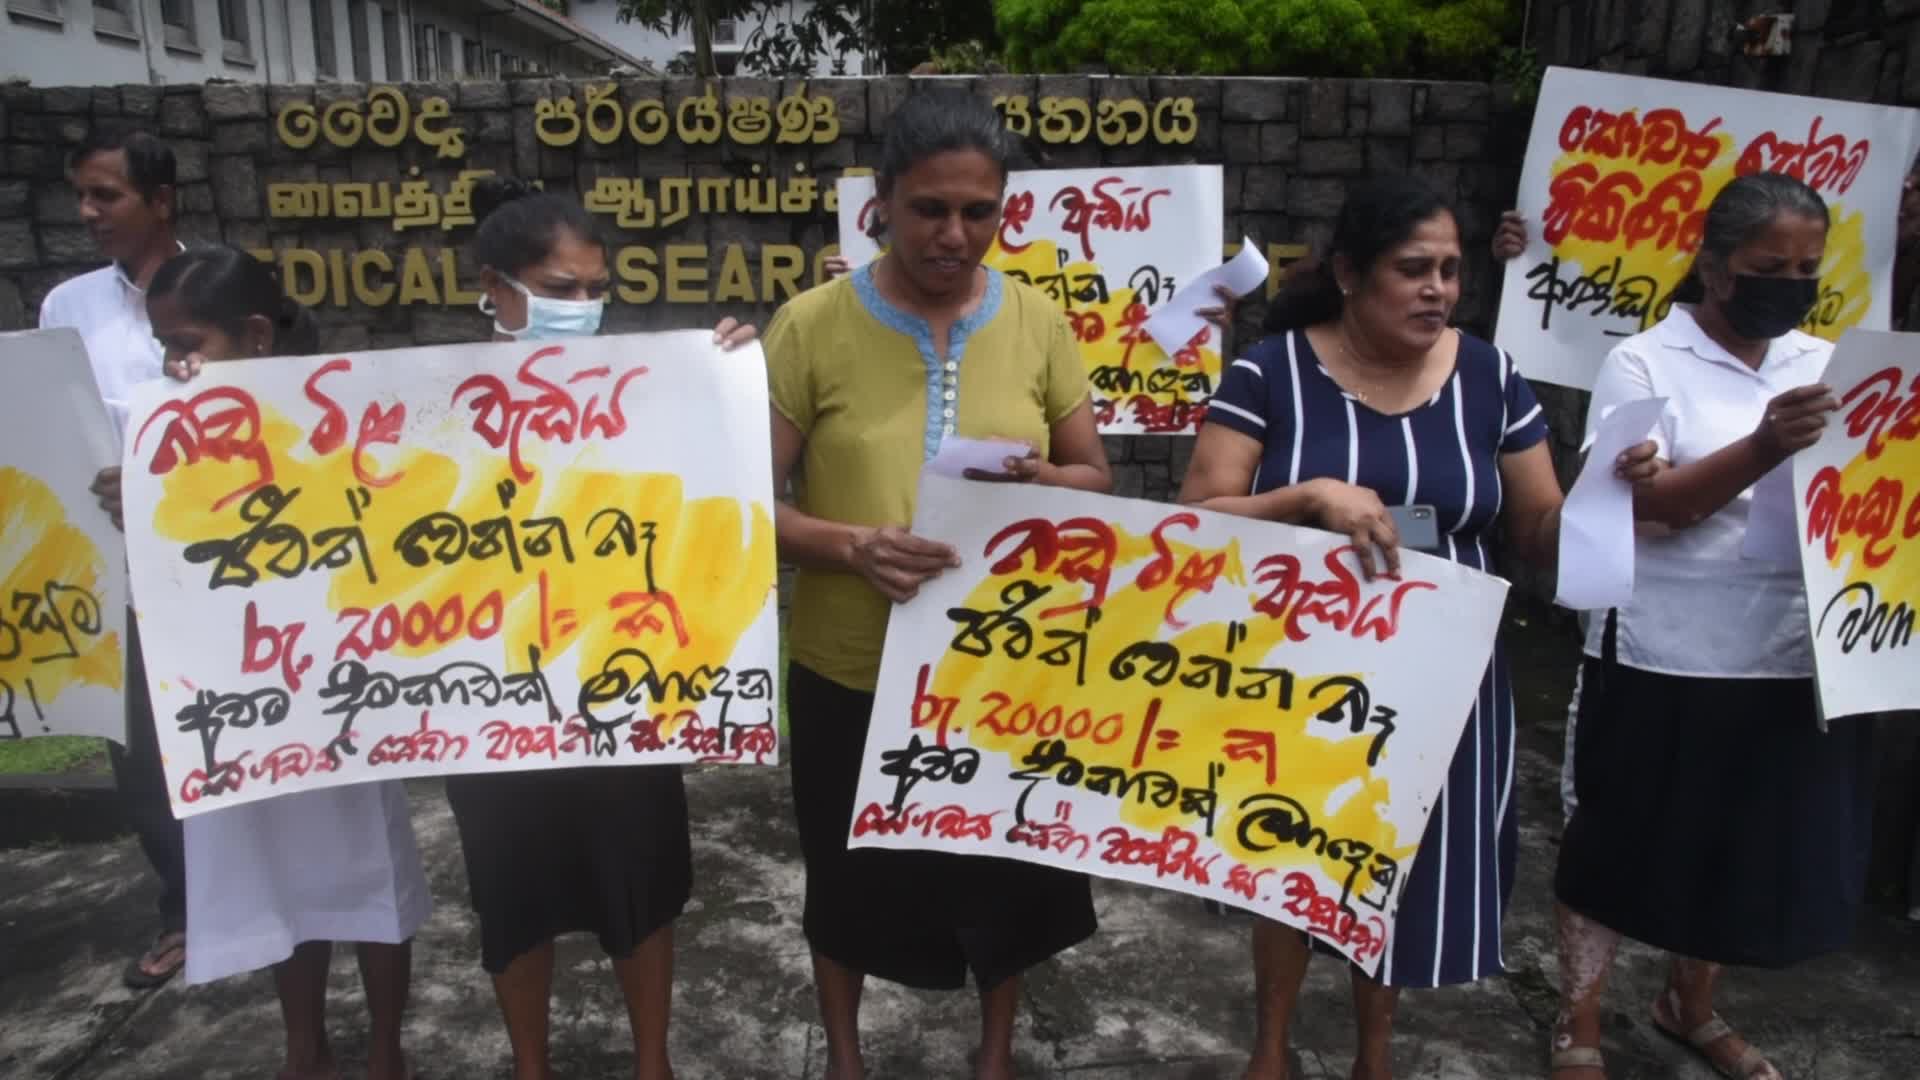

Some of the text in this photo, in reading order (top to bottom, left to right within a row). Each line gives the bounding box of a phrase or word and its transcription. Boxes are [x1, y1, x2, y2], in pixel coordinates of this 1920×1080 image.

[992, 95, 1198, 145] යතනය
[267, 166, 544, 231] வைத்தி
[248, 247, 482, 306] DICAL
